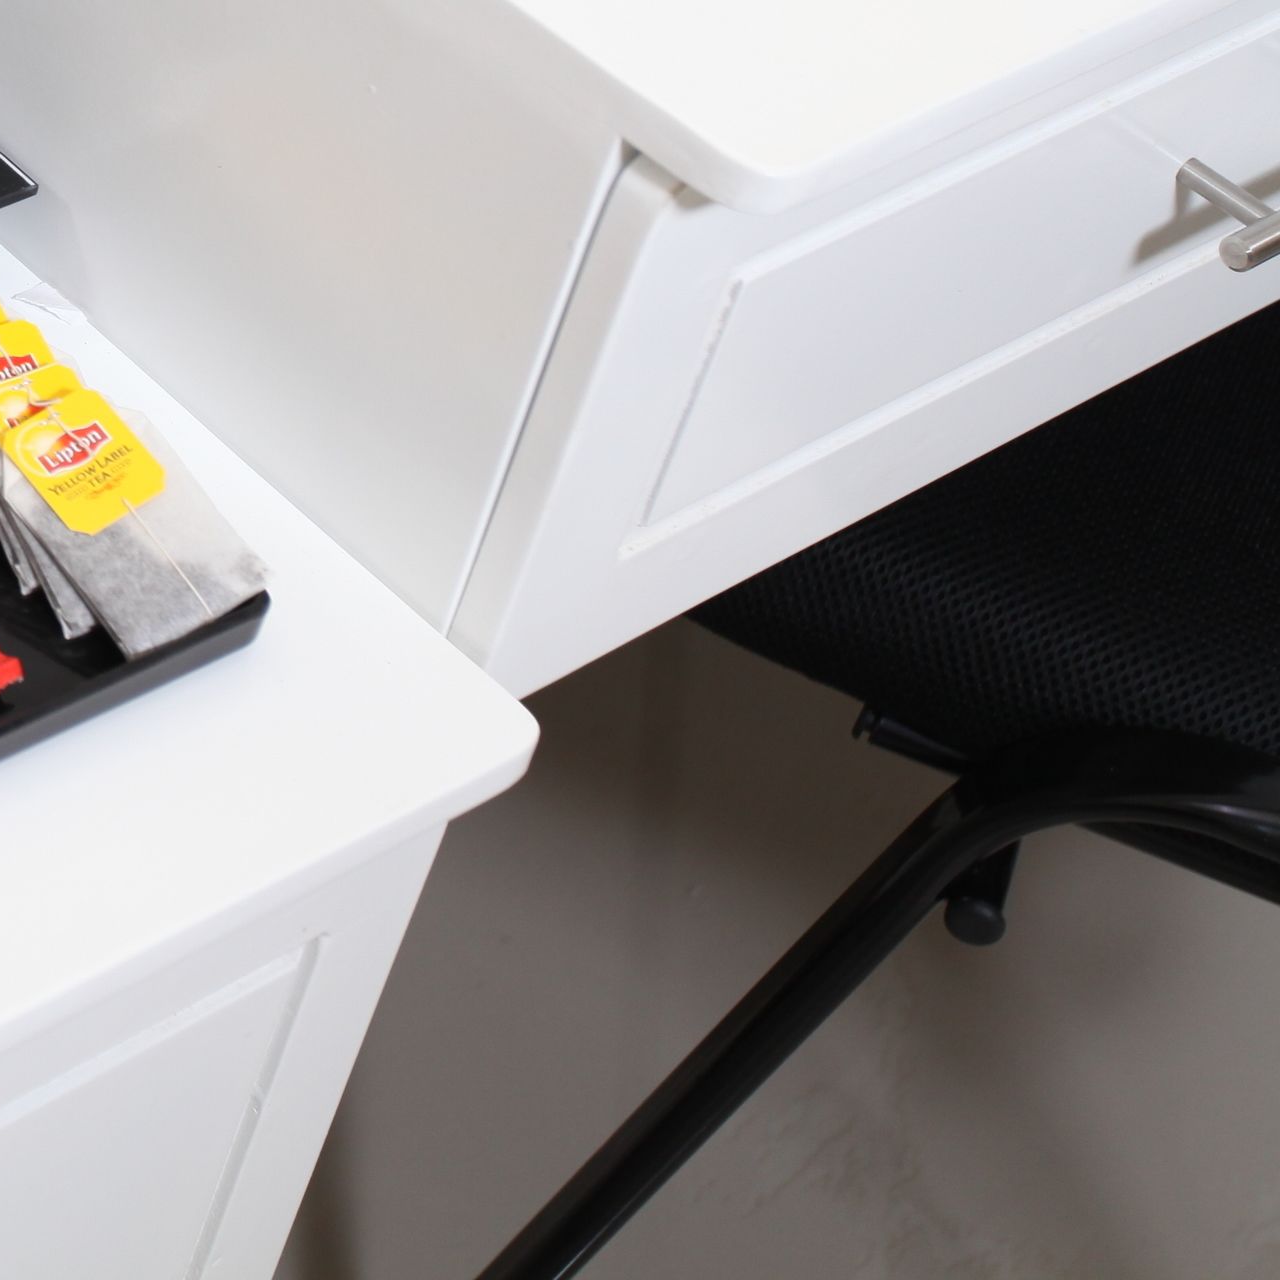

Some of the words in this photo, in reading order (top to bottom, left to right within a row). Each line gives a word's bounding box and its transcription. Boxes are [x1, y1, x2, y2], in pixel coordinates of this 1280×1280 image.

[43, 430, 102, 468] Lipton
[47, 465, 97, 496] YELLOW
[96, 444, 133, 469] LABEL
[86, 471, 113, 488] TEA
